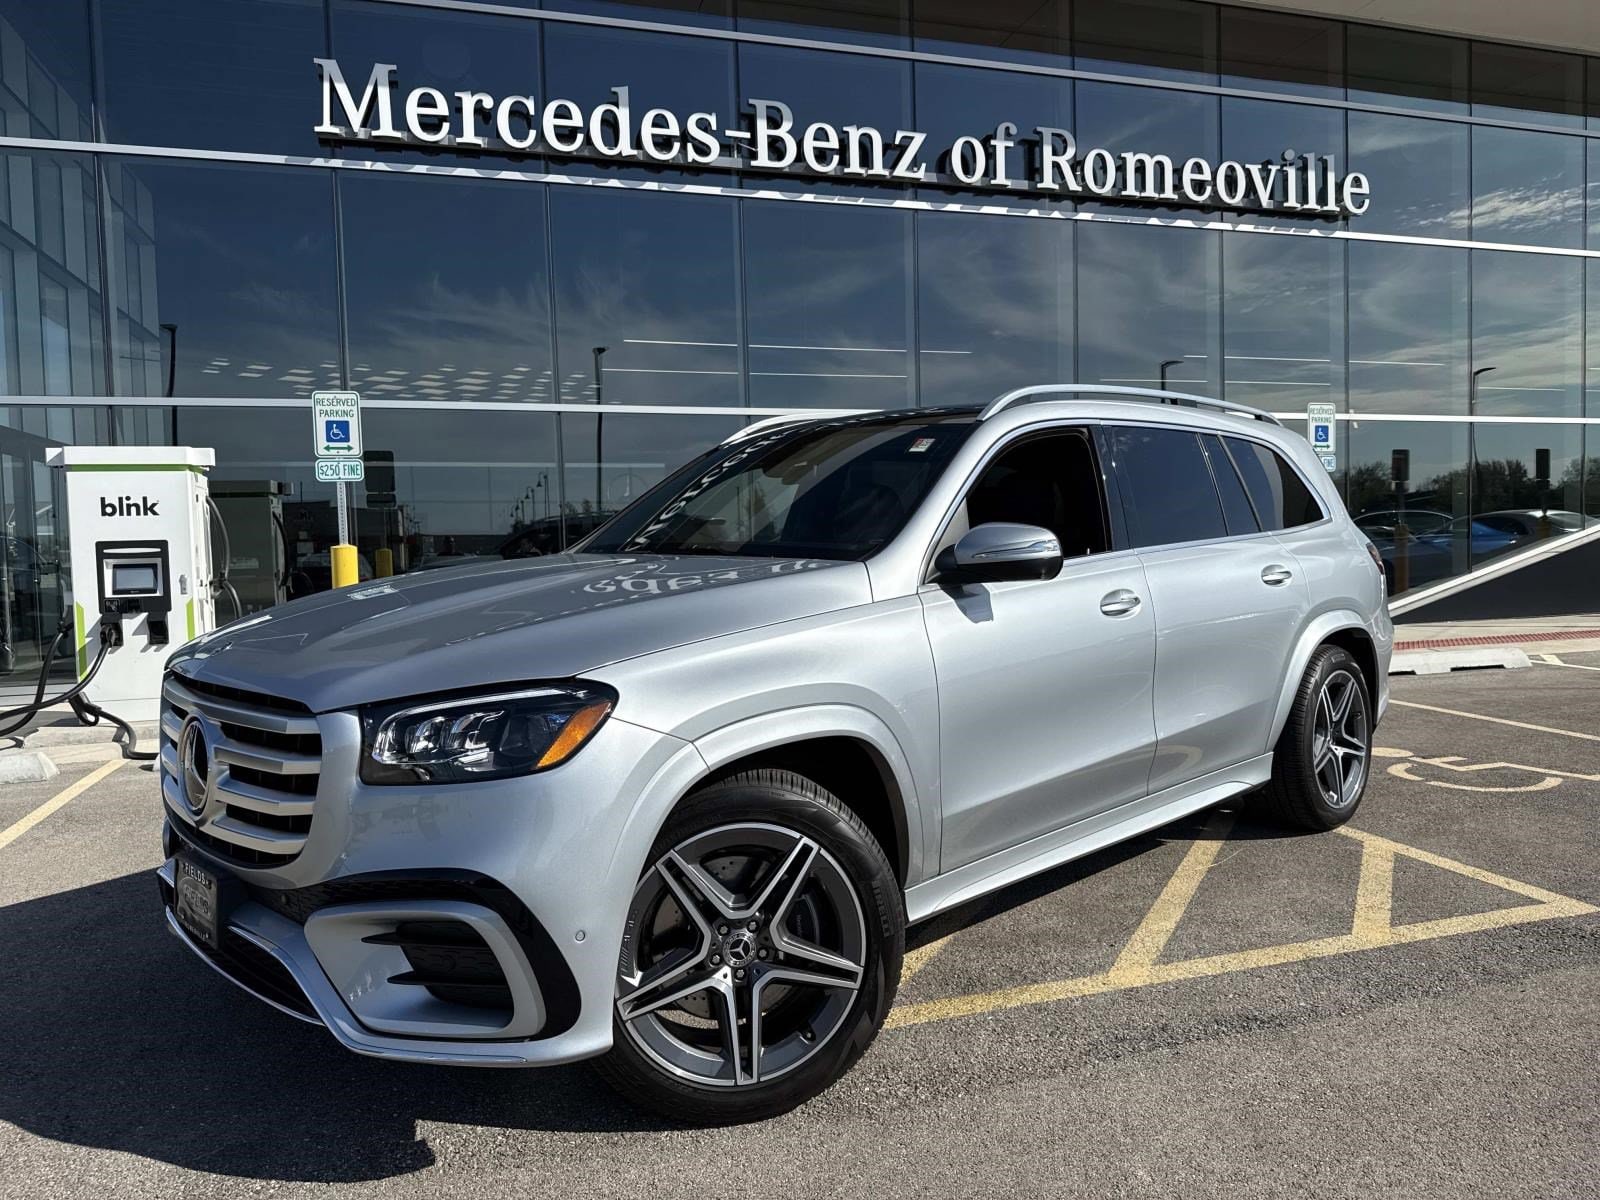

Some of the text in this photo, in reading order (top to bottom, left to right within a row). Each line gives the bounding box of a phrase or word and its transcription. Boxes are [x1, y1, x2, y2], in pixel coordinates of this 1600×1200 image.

[313, 57, 1370, 215] Mercedes-Benz of Romeoville
[315, 397, 356, 407] RESERVED
[319, 409, 355, 418] PARKING
[319, 464, 361, 477] $250 FINE
[100, 496, 160, 517] blink
[185, 862, 206, 885] FIELDS
